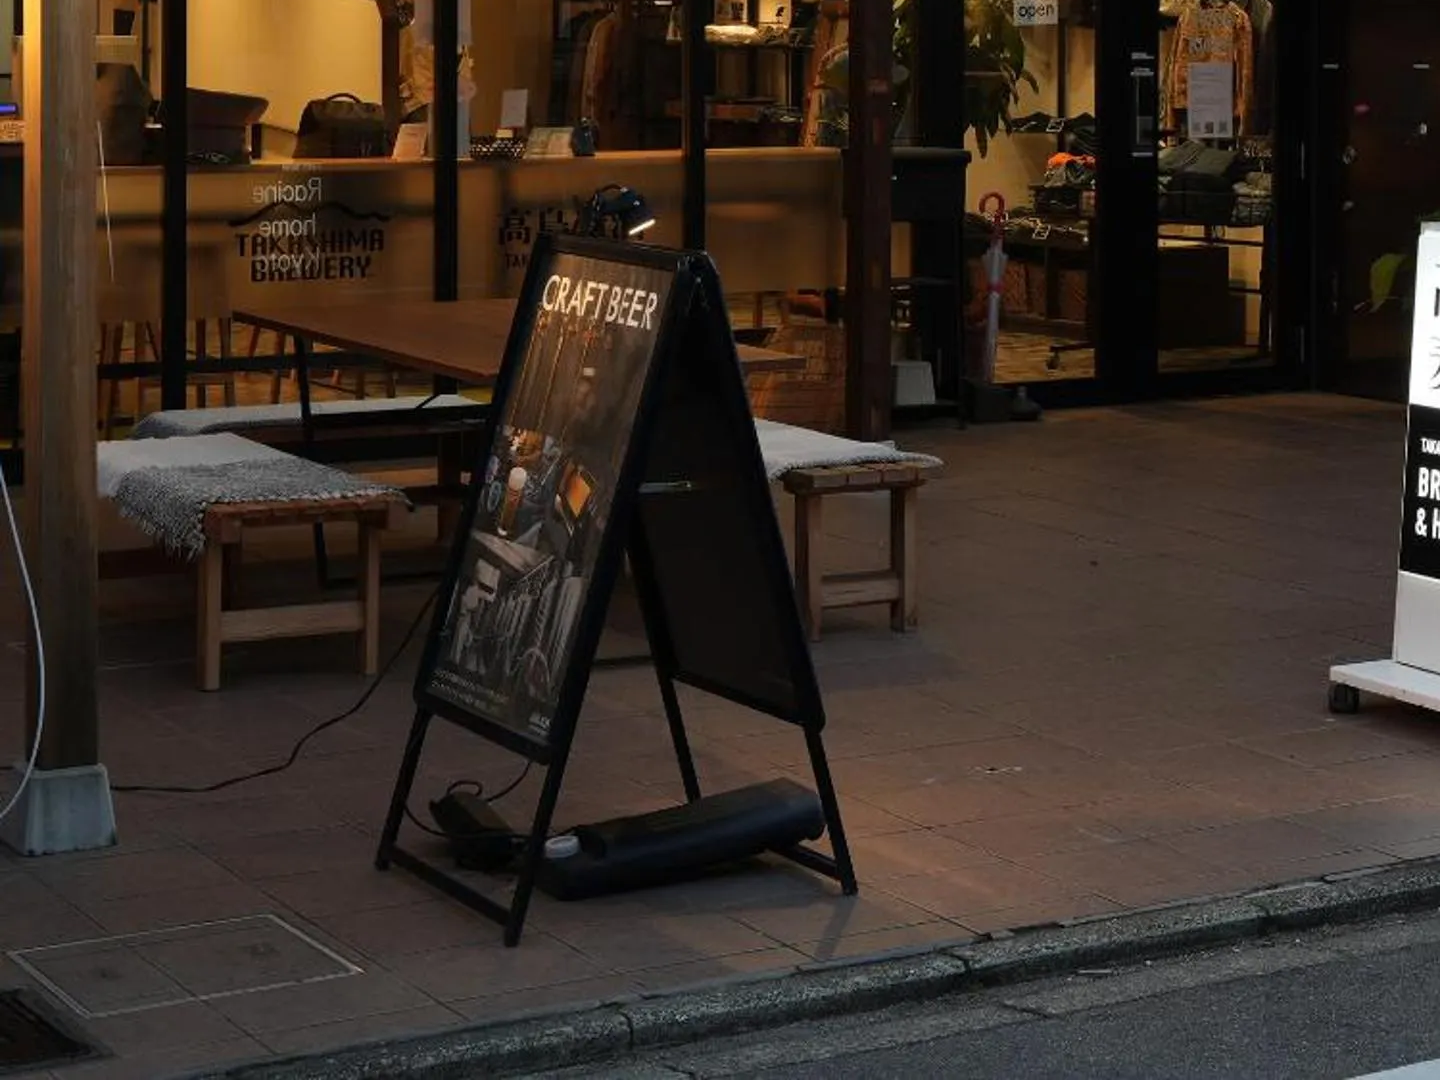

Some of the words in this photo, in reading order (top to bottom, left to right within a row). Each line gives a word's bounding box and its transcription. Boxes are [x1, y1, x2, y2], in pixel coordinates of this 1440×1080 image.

[1018, 2, 1054, 20] open
[542, 275, 609, 321] CRAFT
[605, 286, 658, 330] BEER
[1415, 507, 1427, 537] &
